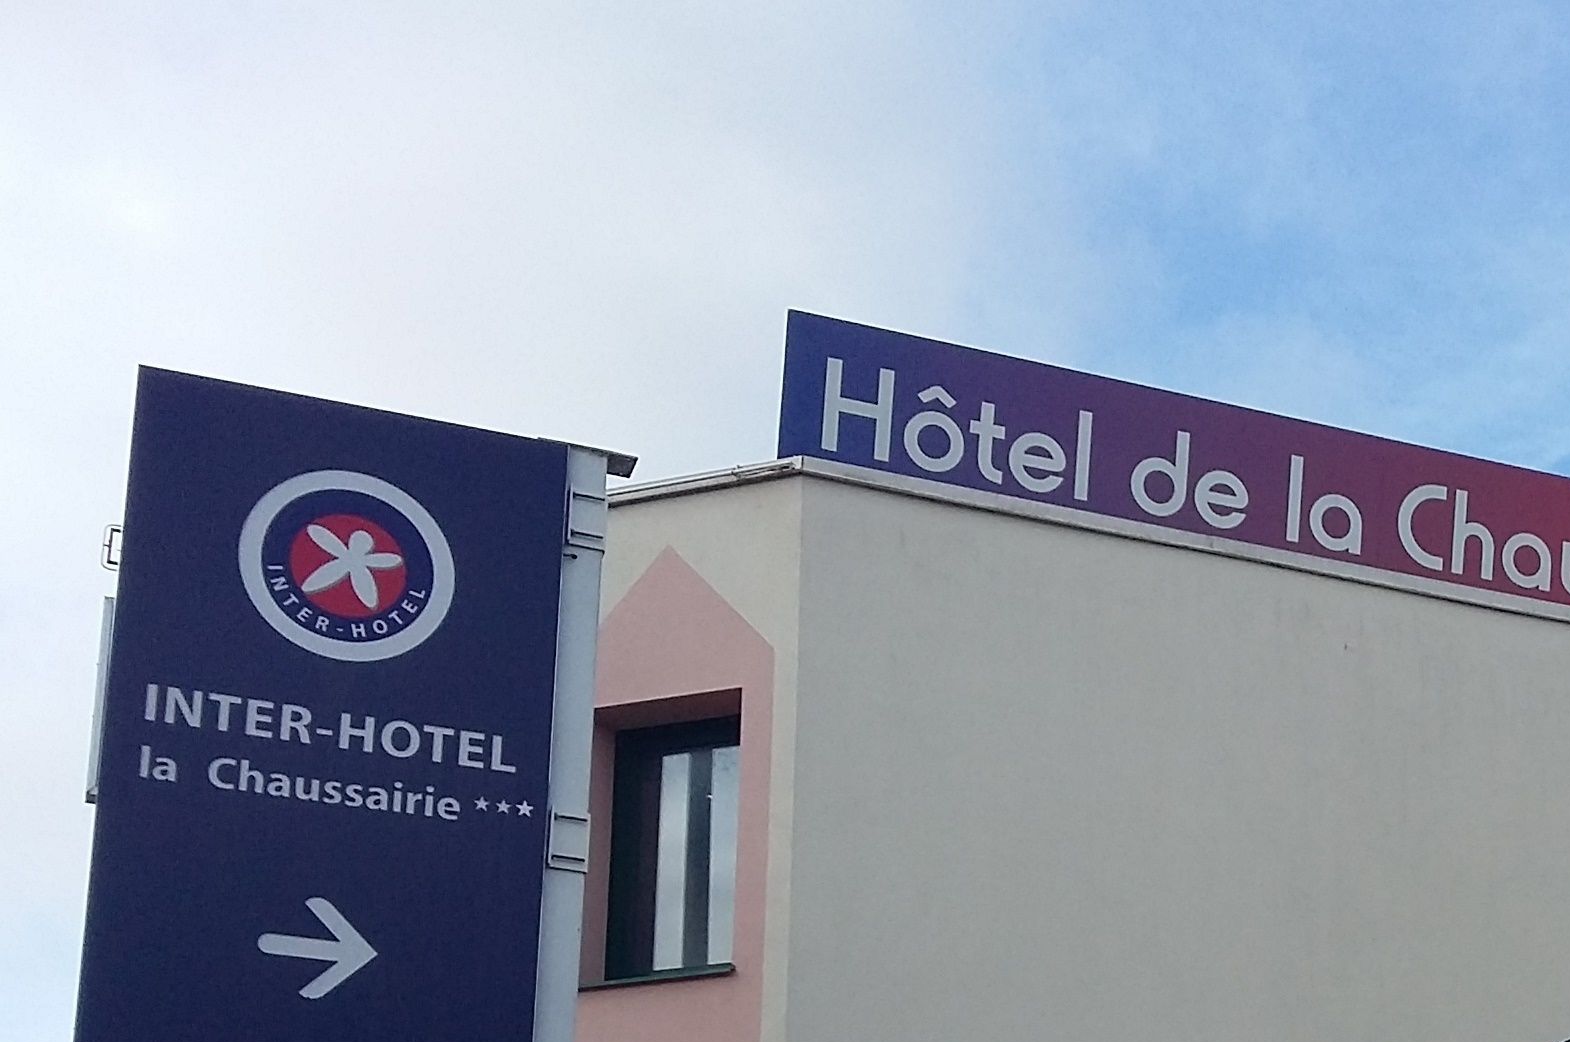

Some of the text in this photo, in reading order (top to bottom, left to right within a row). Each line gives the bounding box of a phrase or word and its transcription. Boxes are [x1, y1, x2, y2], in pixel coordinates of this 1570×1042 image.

[821, 356, 1093, 502] Hôtel
[1130, 430, 1249, 529] de
[1285, 454, 1363, 556] la
[267, 564, 426, 638] INTER-HOTEL
[144, 683, 517, 774] INTER-HOTEL
[138, 745, 461, 821] la Chaussairie
